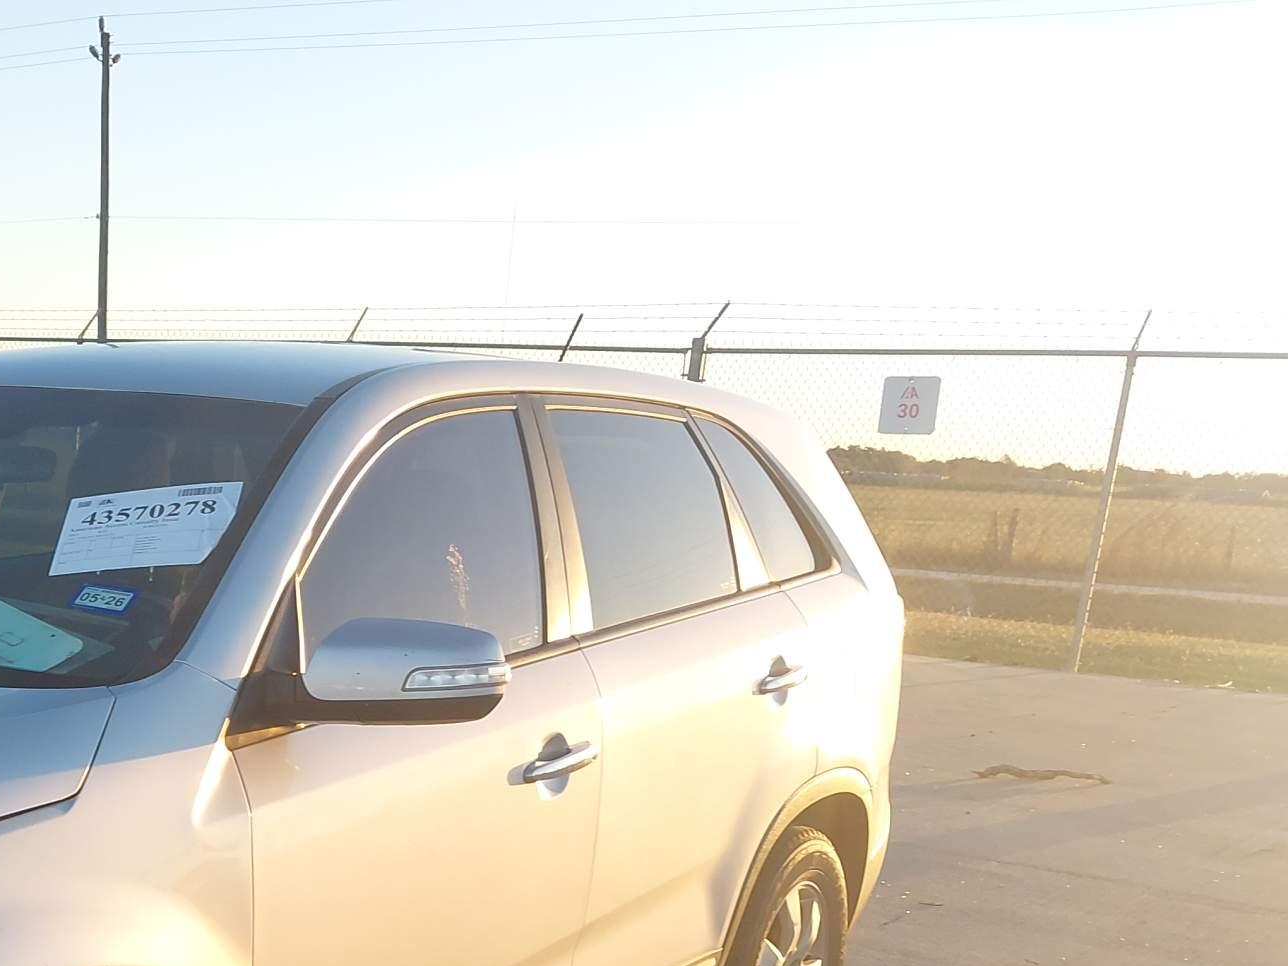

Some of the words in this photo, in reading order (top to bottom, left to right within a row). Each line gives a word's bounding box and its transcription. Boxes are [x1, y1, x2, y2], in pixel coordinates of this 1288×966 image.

[897, 403, 920, 418] 30
[81, 499, 217, 526] 43570278
[79, 592, 101, 603] 05
[103, 595, 126, 607] 26
